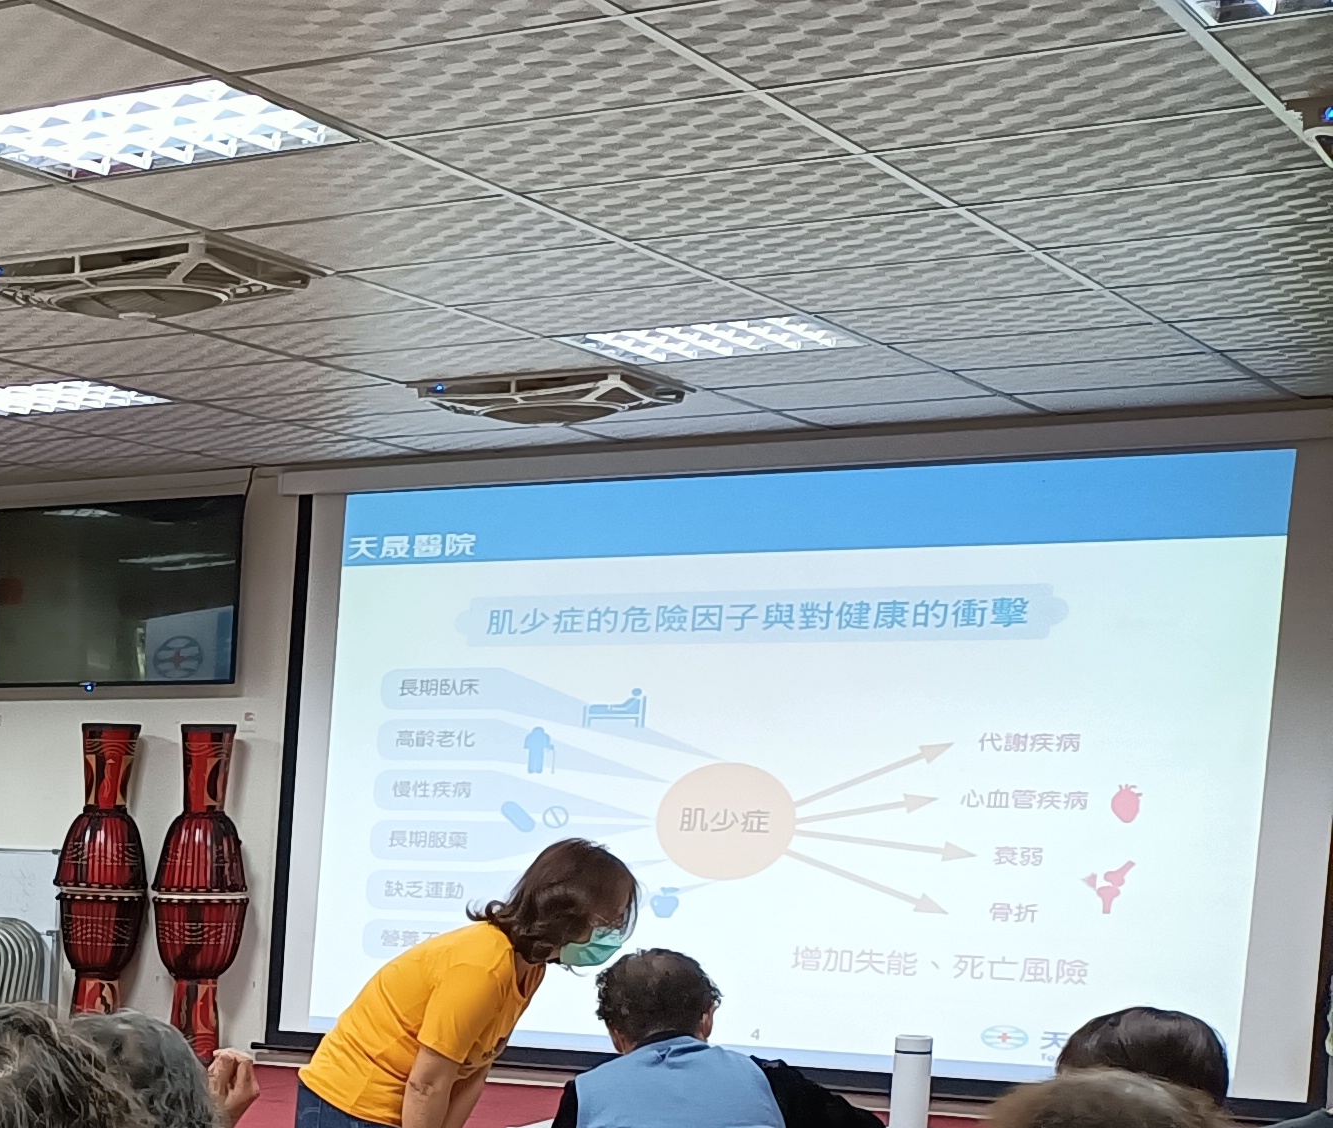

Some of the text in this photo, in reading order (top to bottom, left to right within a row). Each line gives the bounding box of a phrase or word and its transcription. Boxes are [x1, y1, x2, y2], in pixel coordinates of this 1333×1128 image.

[347, 533, 477, 561] 天晟醫院
[485, 596, 1031, 636] 肌少症的危險因子與對健康的衝擊
[398, 678, 480, 697] 長期臥床
[395, 729, 476, 748] 高齡老化
[978, 732, 1082, 753] 代謝疾病
[391, 780, 473, 799] 慢性疾病
[960, 788, 1090, 811] 心血管疾病
[679, 806, 771, 834] 肌少症
[388, 830, 469, 849] 長期服藥
[993, 846, 1044, 867] 衰弱
[384, 880, 465, 900] 缺乏運動
[989, 902, 1039, 924] 骨折
[791, 945, 1090, 986] 增加失能、死亡風險
[750, 1028, 762, 1041] 4
